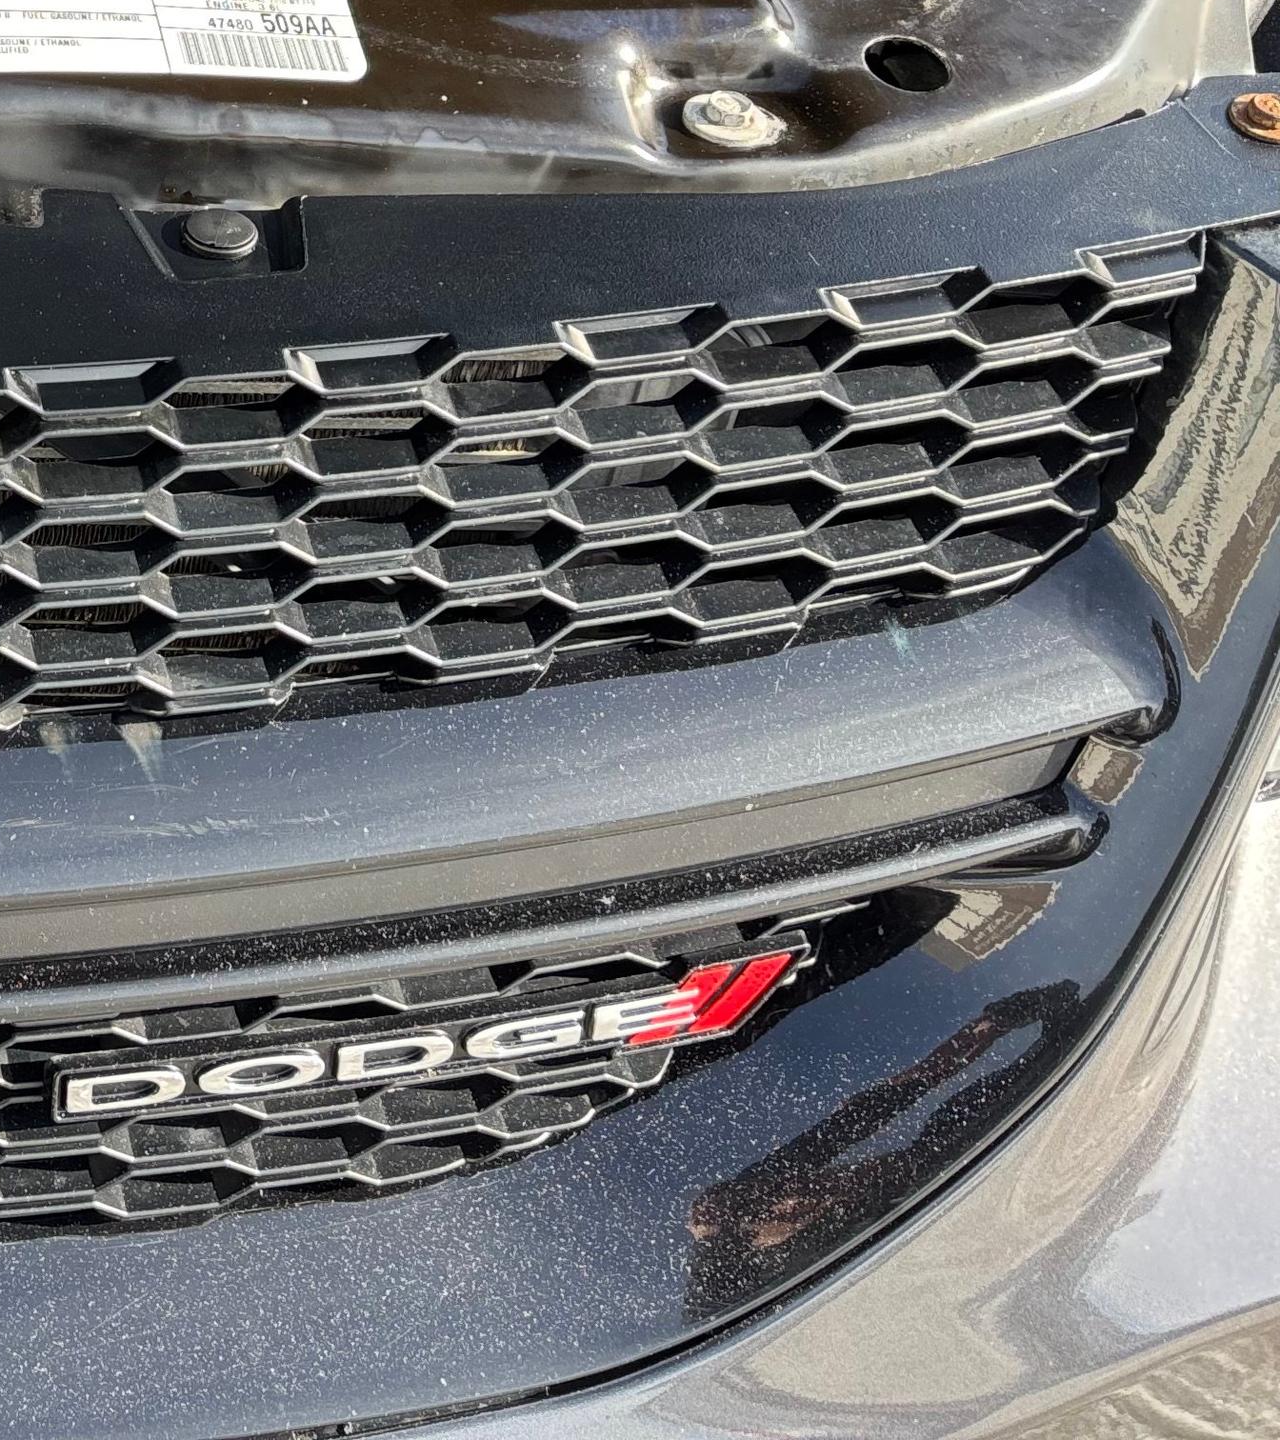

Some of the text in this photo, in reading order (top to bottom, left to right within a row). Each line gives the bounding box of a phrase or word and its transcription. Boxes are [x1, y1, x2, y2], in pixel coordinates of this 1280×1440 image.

[208, 13, 337, 36] 47480 509AA
[65, 987, 701, 1115] DODGE
